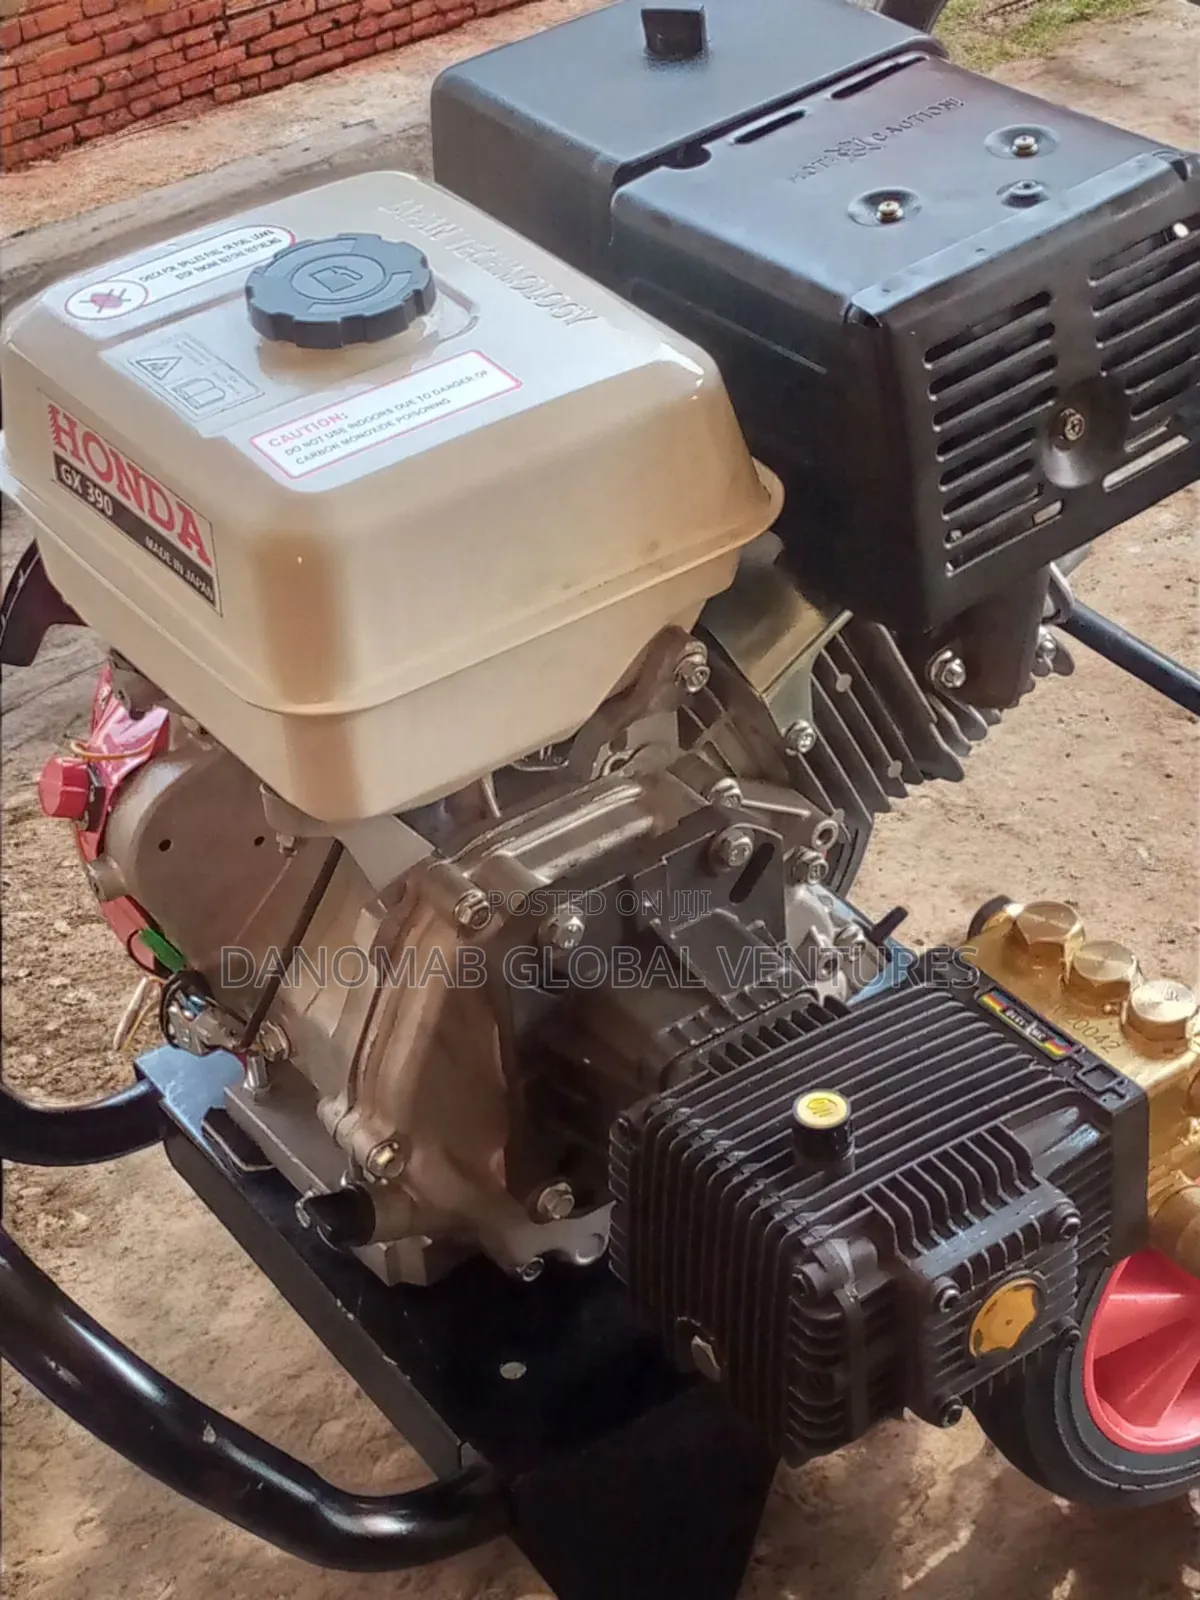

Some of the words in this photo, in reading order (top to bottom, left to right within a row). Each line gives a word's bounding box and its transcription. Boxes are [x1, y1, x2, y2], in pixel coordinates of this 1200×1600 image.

[268, 412, 348, 447] CAUTION:
[284, 444, 302, 456] DO
[302, 434, 325, 449] NOT
[326, 426, 346, 441] USE
[347, 408, 394, 431] INDOORS
[394, 398, 415, 413] DUE
[417, 393, 432, 404] TO
[432, 376, 473, 397] DANGER
[474, 369, 488, 380] OF
[295, 444, 341, 466] CARBON
[343, 420, 401, 447] MONOXIDE
[49, 402, 212, 568] HONDA
[60, 465, 83, 495] GX
[85, 482, 113, 516] 390
[145, 535, 174, 567] MADE
[173, 558, 185, 576] IN
[184, 566, 214, 600] JAPAN
